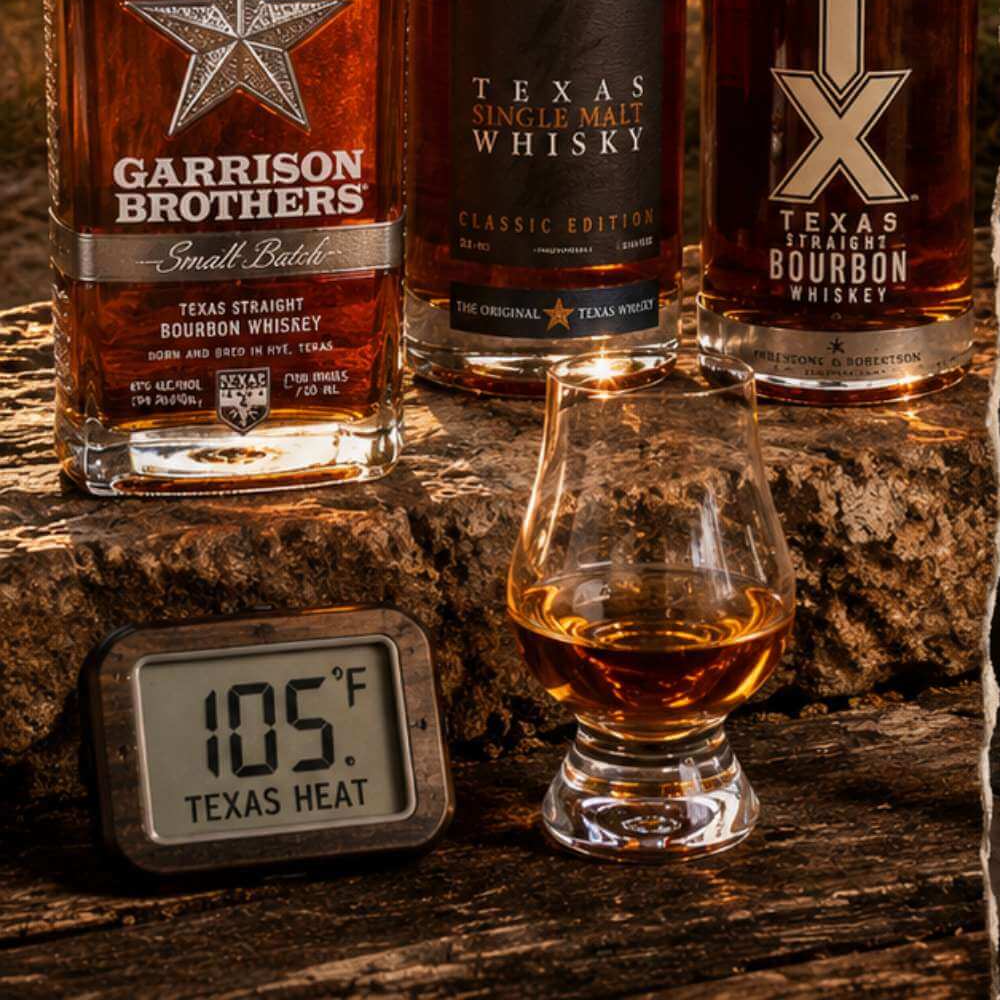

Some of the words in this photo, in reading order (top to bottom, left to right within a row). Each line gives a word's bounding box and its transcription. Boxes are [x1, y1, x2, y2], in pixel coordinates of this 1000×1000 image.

[472, 75, 644, 103] TEXAS
[472, 103, 569, 129] SINGLE
[579, 102, 644, 128] MALT
[472, 127, 643, 157] WHISKY
[113, 149, 365, 189] GARRISON
[114, 183, 364, 223] BROTHERS
[458, 210, 551, 233] CLASSIC
[568, 208, 654, 233] EDITION
[780, 210, 897, 233] TEXAS
[156, 239, 247, 273] Small
[244, 236, 331, 269] Batch
[786, 233, 887, 250] STRAIGHT
[769, 249, 907, 284] BOURBON
[178, 302, 226, 317] TEXAS
[232, 297, 304, 315] STRAIGHT
[790, 286, 887, 304] WHISKEY
[457, 300, 478, 315] THE
[480, 305, 541, 320] ORIGINAL
[578, 304, 616, 320] TEXAS
[160, 320, 240, 339] BOURBON
[185, 787, 282, 823] TEXAS
[294, 779, 368, 813] HEAT
